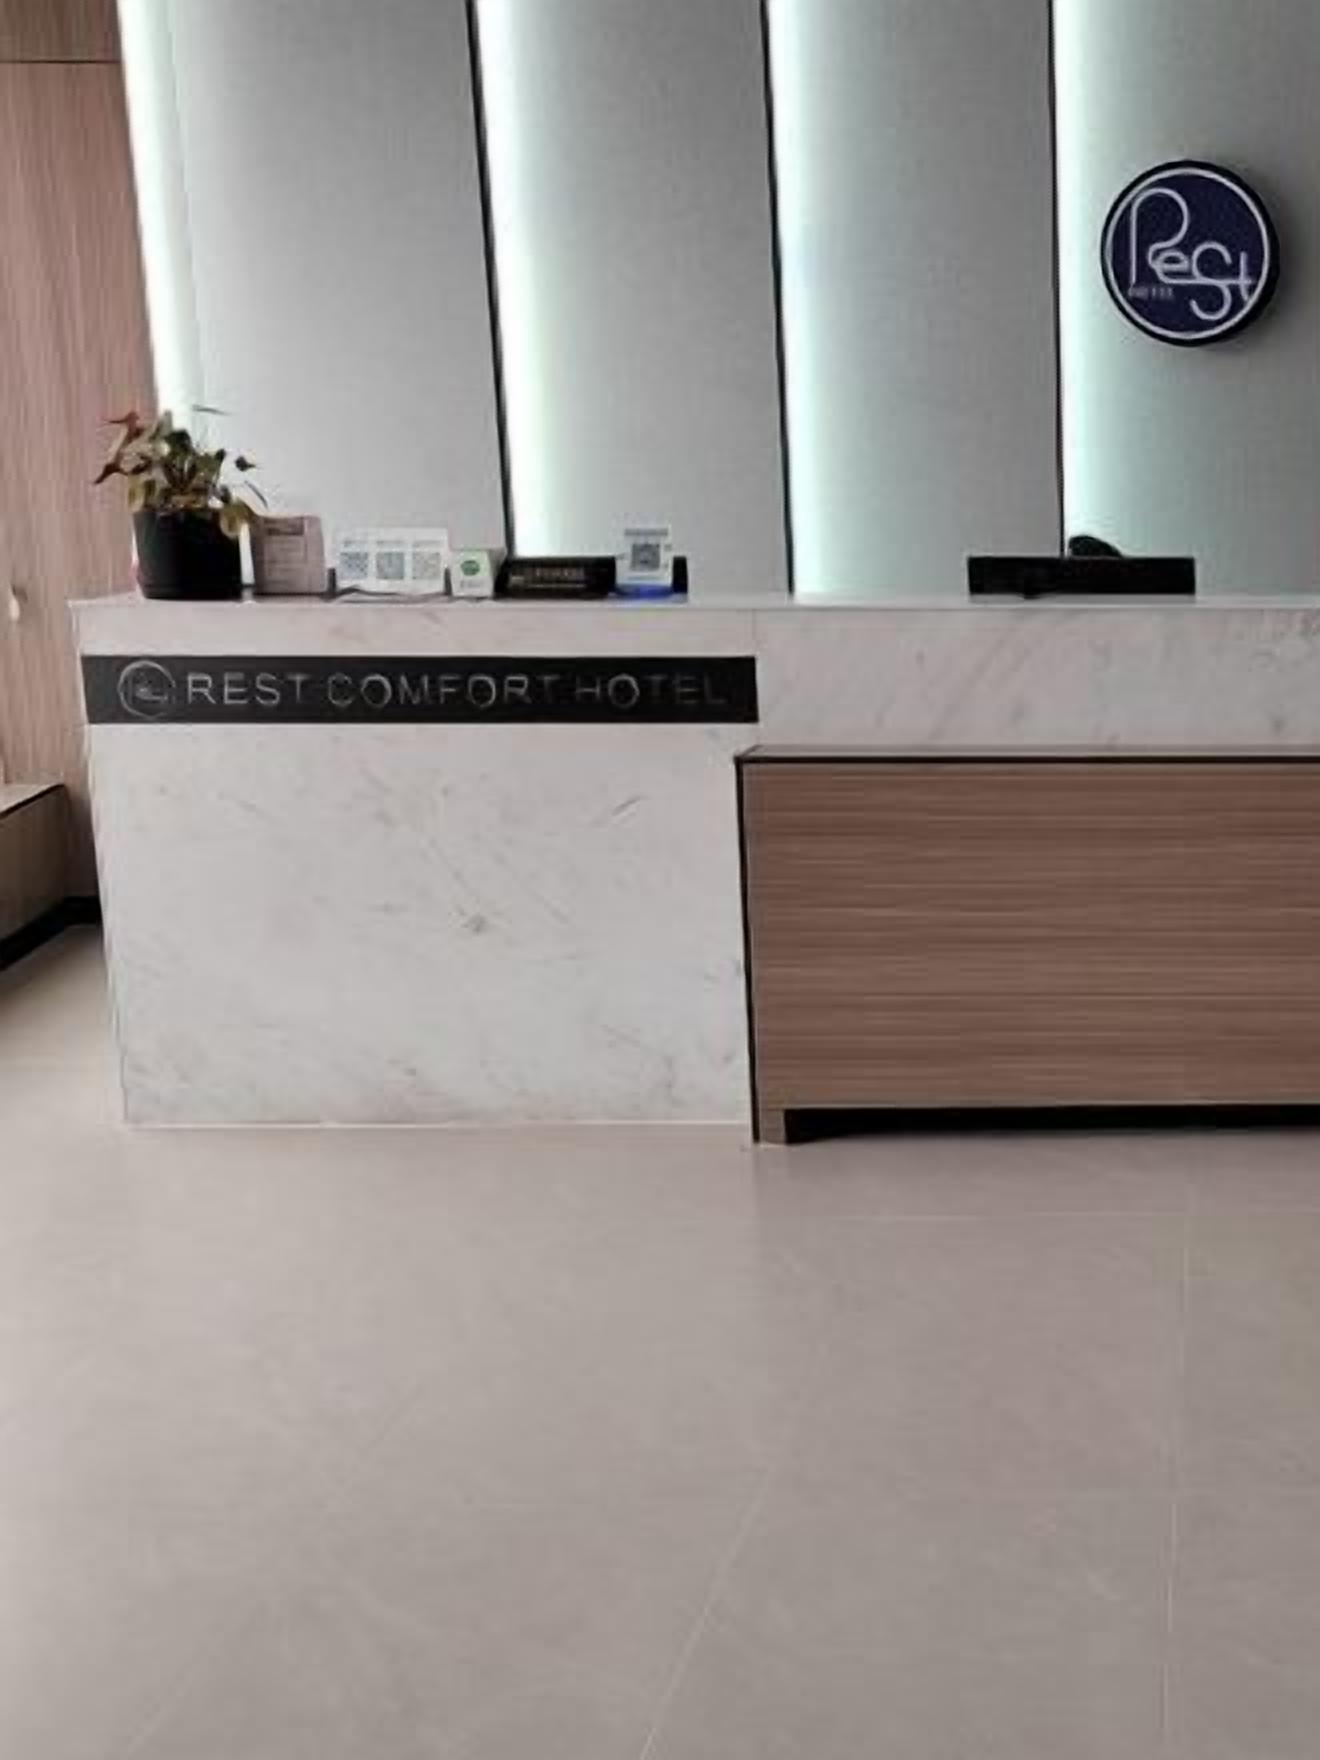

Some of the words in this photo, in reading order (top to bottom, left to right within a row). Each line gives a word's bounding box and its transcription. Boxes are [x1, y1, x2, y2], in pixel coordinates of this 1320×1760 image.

[187, 672, 309, 706] REST
[327, 673, 561, 708] COMFORT
[575, 674, 726, 708] HOTEL
